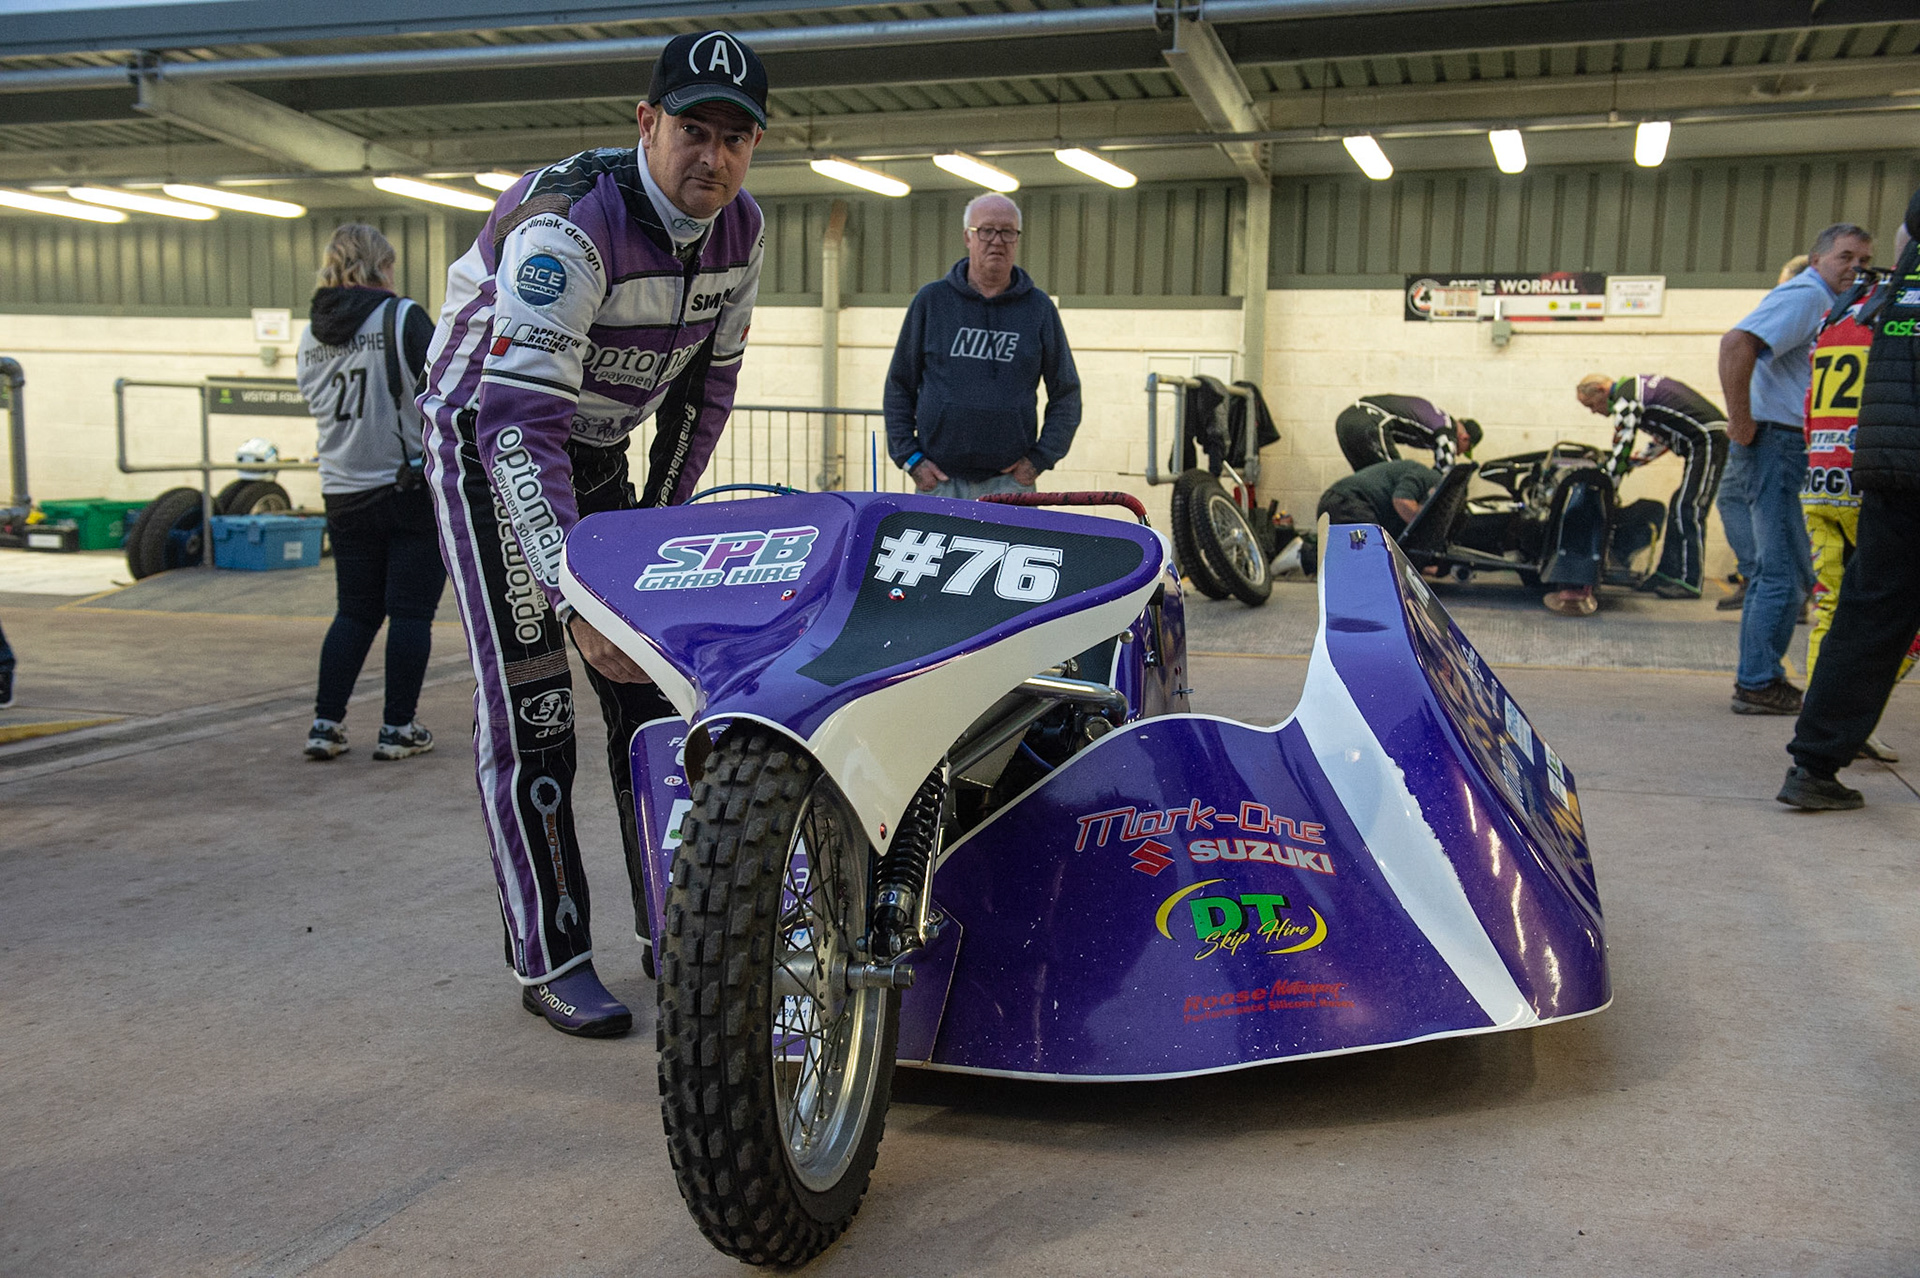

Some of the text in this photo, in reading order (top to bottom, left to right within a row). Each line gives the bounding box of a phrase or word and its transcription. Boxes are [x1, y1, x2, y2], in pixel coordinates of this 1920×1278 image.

[565, 227, 600, 272] design
[520, 265, 565, 287] ACE
[1500, 279, 1578, 294] WORRALL
[528, 335, 568, 352] RACING
[950, 327, 1019, 362] NIKE
[331, 367, 367, 422] 27
[1814, 353, 1861, 410] 72
[493, 467, 522, 520] payment
[516, 522, 546, 578] solutions
[646, 526, 819, 574] SPB
[874, 528, 1064, 603] #76
[636, 564, 804, 591] GRAB HIRE
[1074, 798, 1327, 853] Mark-One
[1188, 838, 1335, 875] SUZUKI
[1189, 893, 1288, 940] DT
[1194, 918, 1311, 961] Skip Hire
[538, 985, 577, 1017] aytona
[1183, 988, 1268, 1013] Roose
[1267, 1000, 1317, 1011] Silicone
